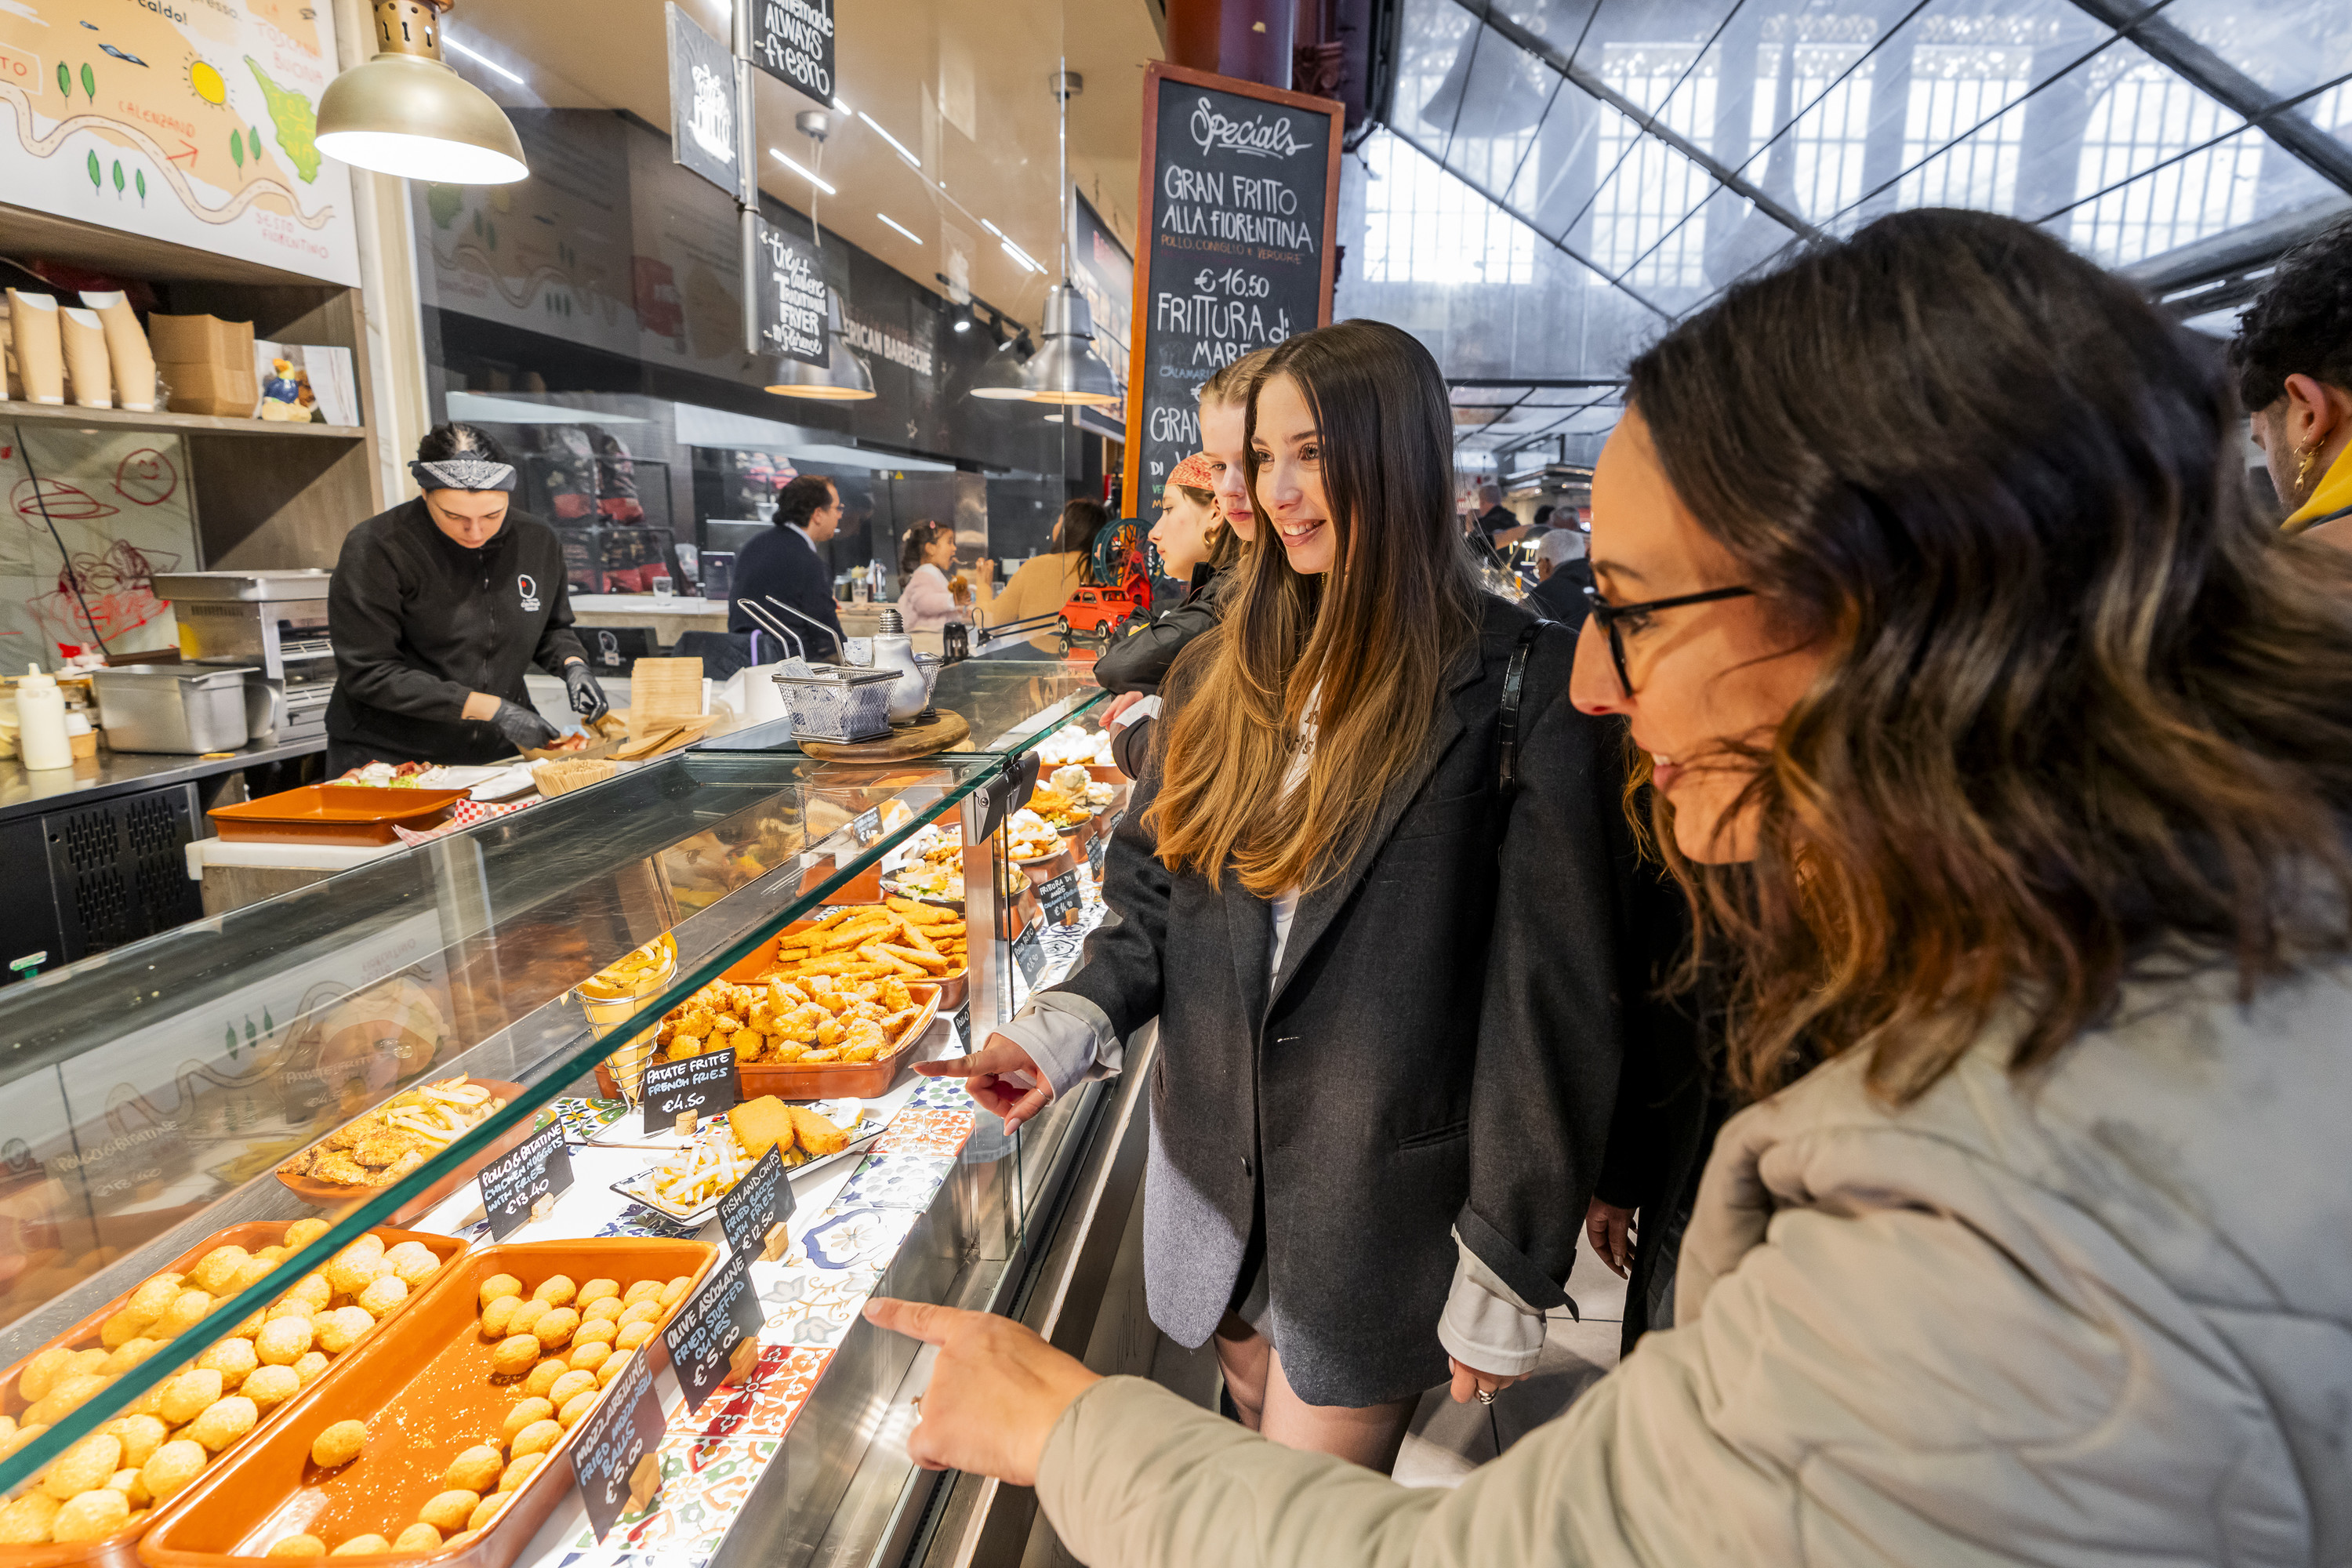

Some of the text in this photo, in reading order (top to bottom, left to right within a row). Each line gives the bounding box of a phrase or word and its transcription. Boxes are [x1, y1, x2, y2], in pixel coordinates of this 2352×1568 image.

[765, 2, 822, 61] ALWAYS
[764, 33, 830, 96] fresh
[118, 100, 196, 139] CALENZANO
[1190, 96, 1313, 156] Specials
[1164, 165, 1298, 216] GRAN FRITTO
[1162, 205, 1315, 253] ALLA FIORENTINA
[780, 302, 819, 336] FRYER
[1157, 292, 1290, 344] FRITTURA di
[1150, 461, 1164, 477] DI
[647, 1052, 730, 1084] PATATE FRITTE
[648, 1067, 728, 1096] FRENCH FRIES
[662, 1092, 706, 1112] €4.50
[482, 1123, 562, 1187] POLLO & PATATINE
[484, 1136, 564, 1201] CHICKEN NUGGETS
[487, 1163, 546, 1212] WITH FRIES
[505, 1178, 549, 1214] €13.40
[721, 1149, 780, 1218] FISH AND CHIPS
[724, 1205, 750, 1233] FRIED
[729, 1187, 775, 1245] WITH FRIES
[667, 1255, 745, 1348] OLIVE ASCOLANE
[673, 1280, 745, 1367] FRIED STUFFED
[580, 1442, 610, 1486] FRIED
[601, 1419, 636, 1479] BALLS
